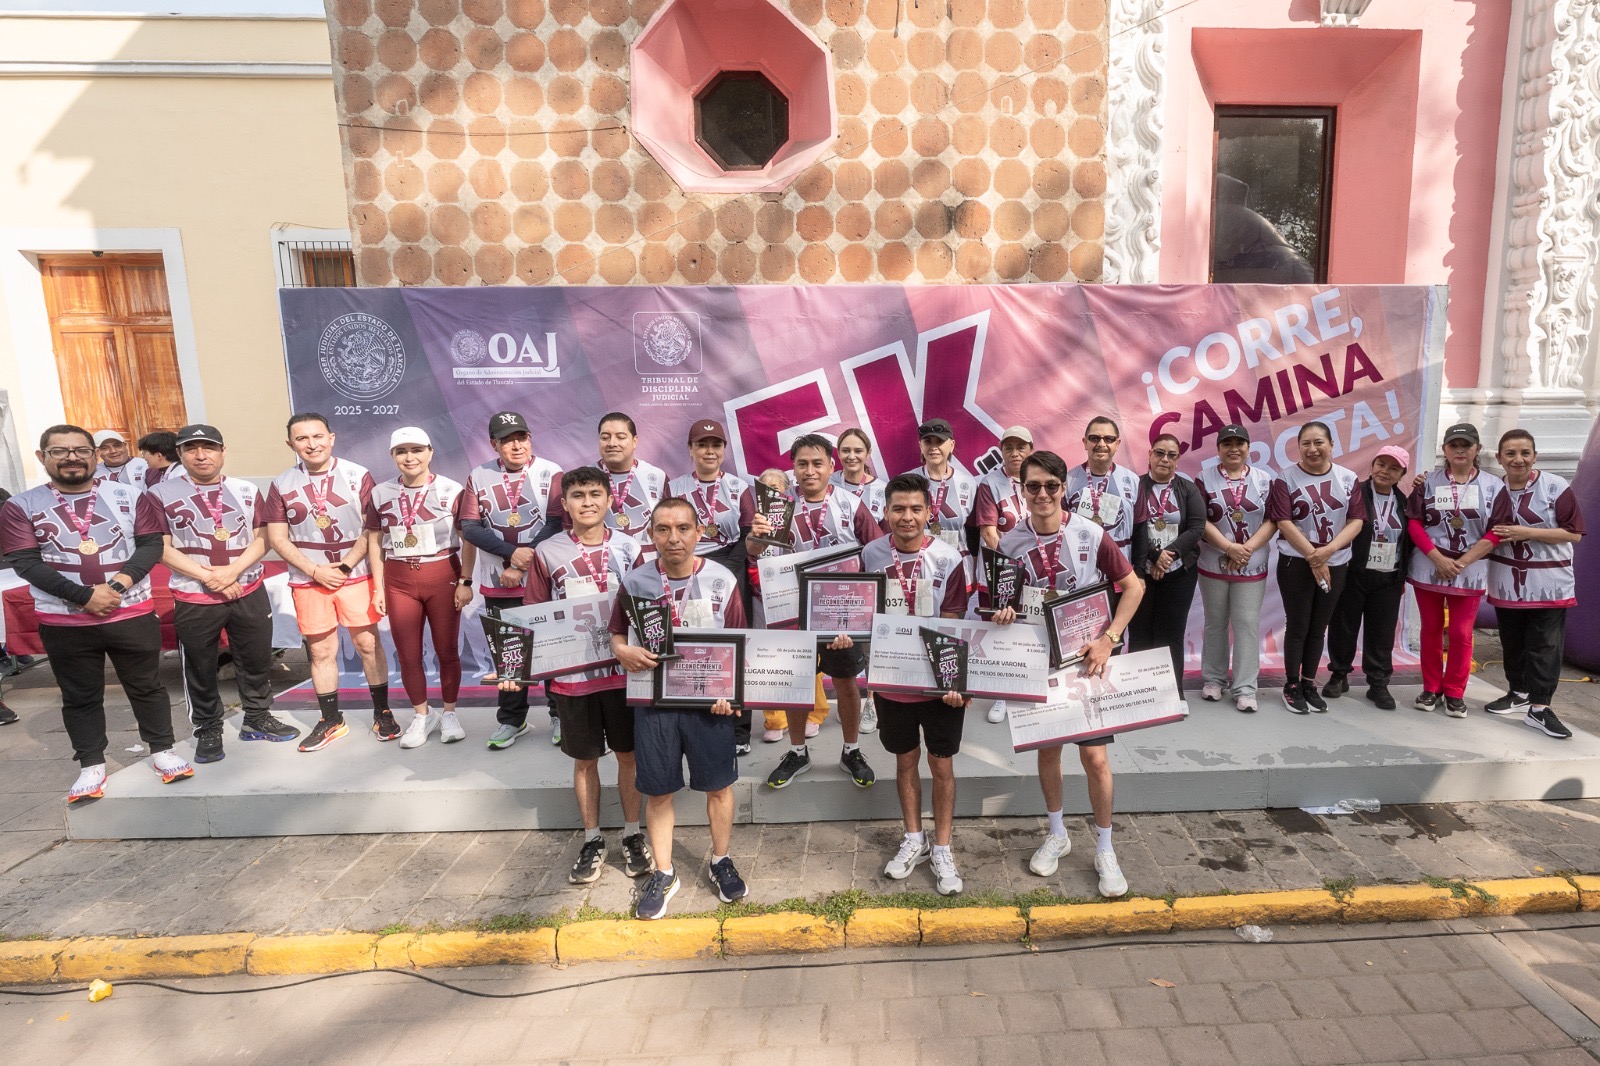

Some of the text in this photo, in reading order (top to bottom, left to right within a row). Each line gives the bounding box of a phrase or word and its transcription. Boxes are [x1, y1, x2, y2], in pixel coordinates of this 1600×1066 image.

[320, 315, 403, 384] PODER JUDICIAL DEL ESTADO DE TLAXCALA
[488, 332, 558, 372] OAJ
[1141, 287, 1363, 415] ¡CORRE,
[1149, 342, 1384, 456] CAMINA
[334, 406, 362, 415] 2025
[372, 405, 399, 414] 2027
[499, 414, 518, 424] NY
[1201, 389, 1404, 480] ROTA!
[1292, 480, 1344, 520] 5K
[164, 489, 238, 530] 5K
[998, 581, 1015, 593] 5K
[886, 598, 909, 607] 0375
[1023, 604, 1045, 616] 0195
[644, 622, 665, 637] 5K
[502, 648, 523, 662] 5K
[939, 659, 958, 672] 5K
[1090, 686, 1158, 704] QUINTO LUGAR VARONIL
